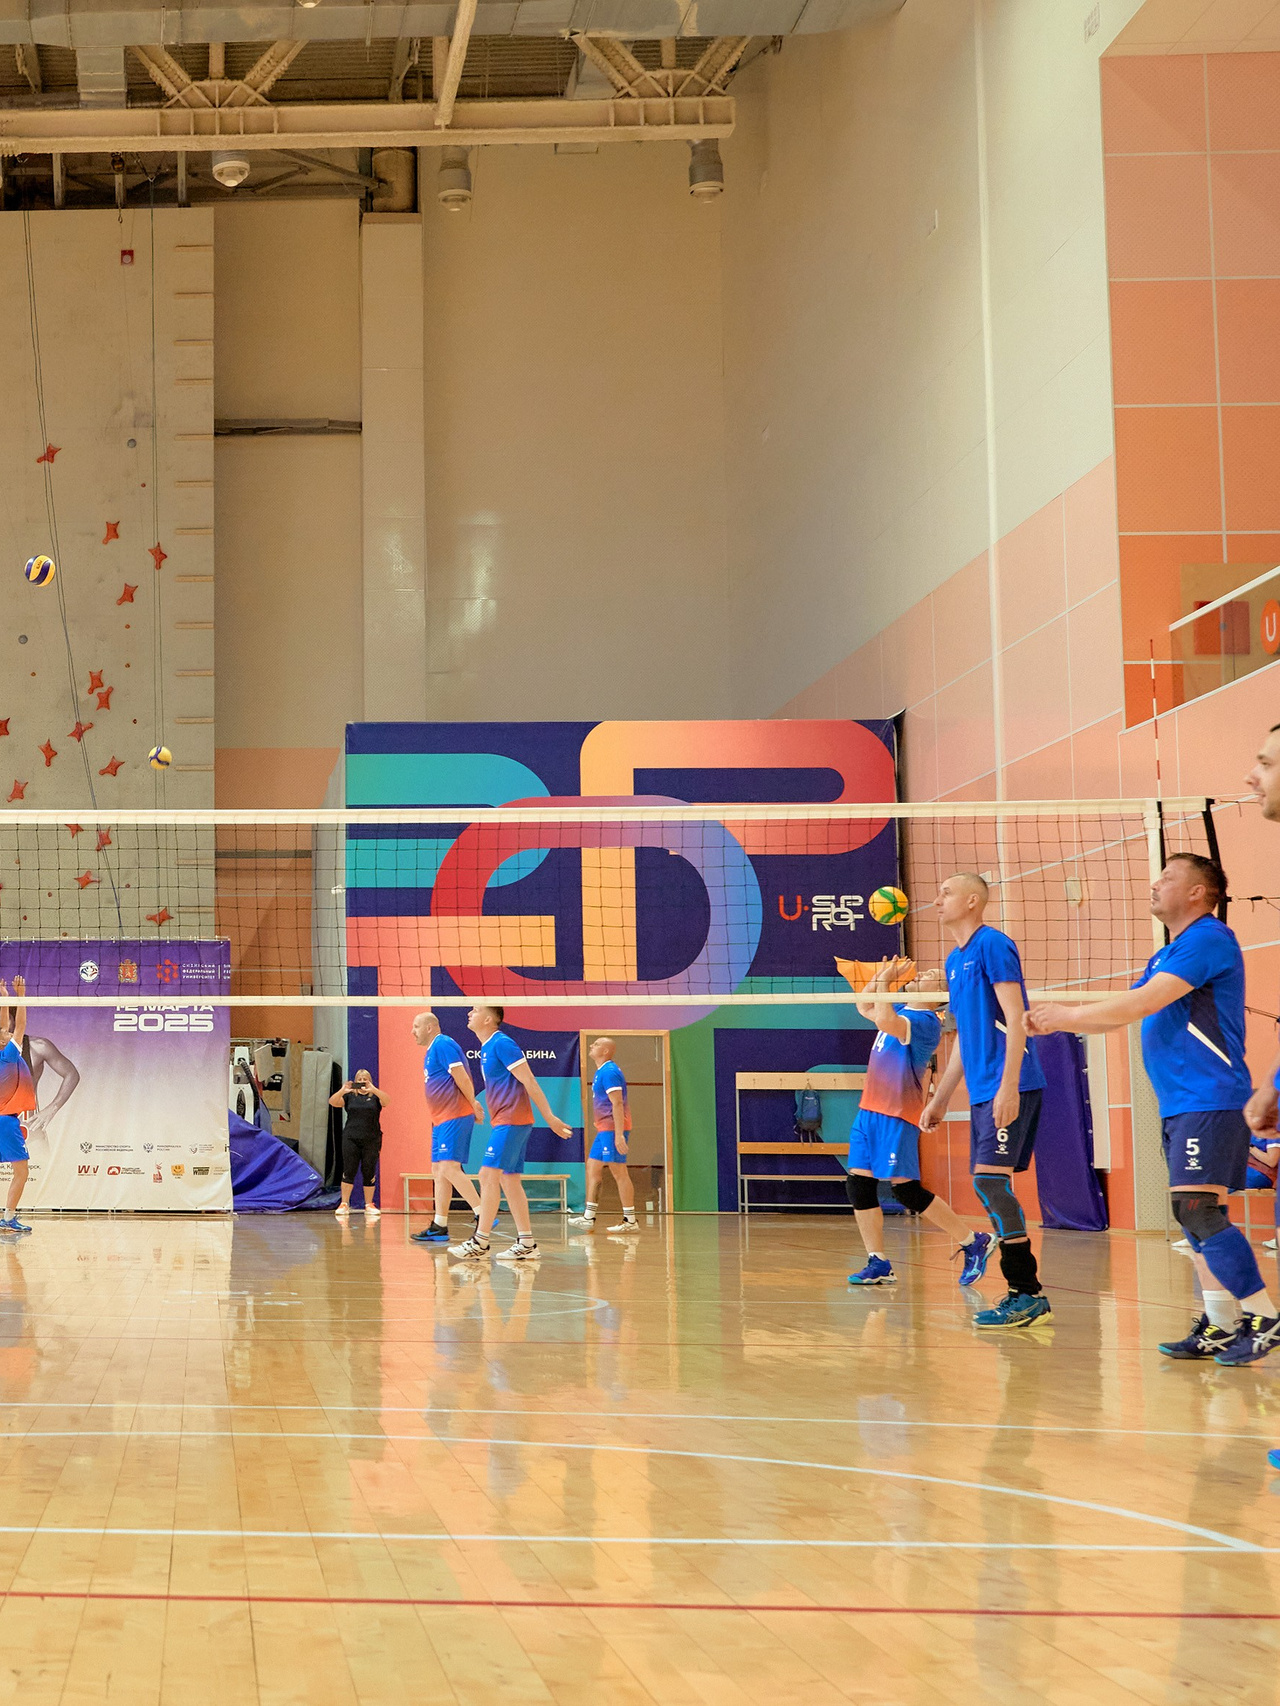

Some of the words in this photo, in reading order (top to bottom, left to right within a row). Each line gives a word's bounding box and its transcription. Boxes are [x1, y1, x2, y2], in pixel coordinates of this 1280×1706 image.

[1266, 612, 1276, 642] U
[113, 1014, 214, 1032] 2025
[872, 1030, 888, 1053] 14
[996, 1128, 1009, 1143] 6
[1185, 1138, 1200, 1156] 5
